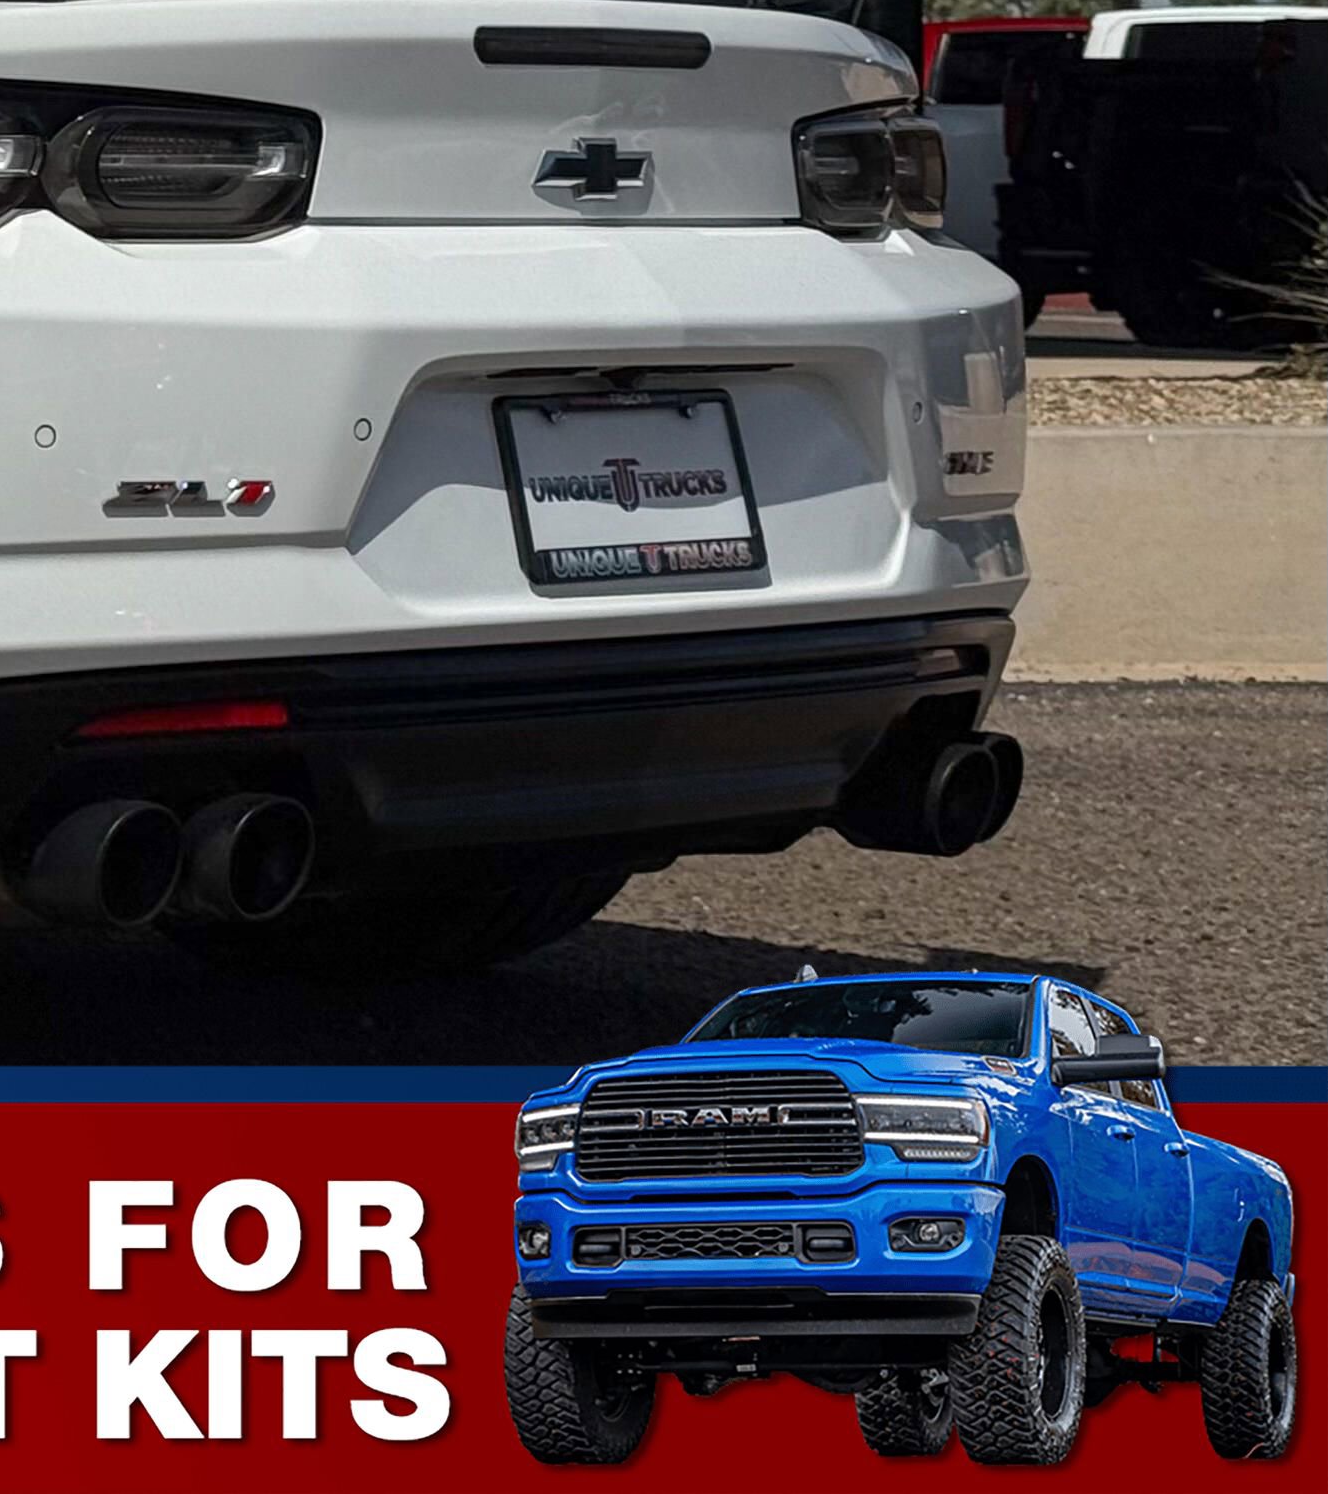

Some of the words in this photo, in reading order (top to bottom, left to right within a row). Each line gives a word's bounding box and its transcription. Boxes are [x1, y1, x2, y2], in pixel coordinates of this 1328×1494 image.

[101, 480, 276, 518] ZL1
[528, 474, 613, 503] UNIQUE
[638, 469, 728, 499] TRUCKS
[550, 546, 641, 578] UNIQUE
[661, 540, 752, 571] TRUCKS
